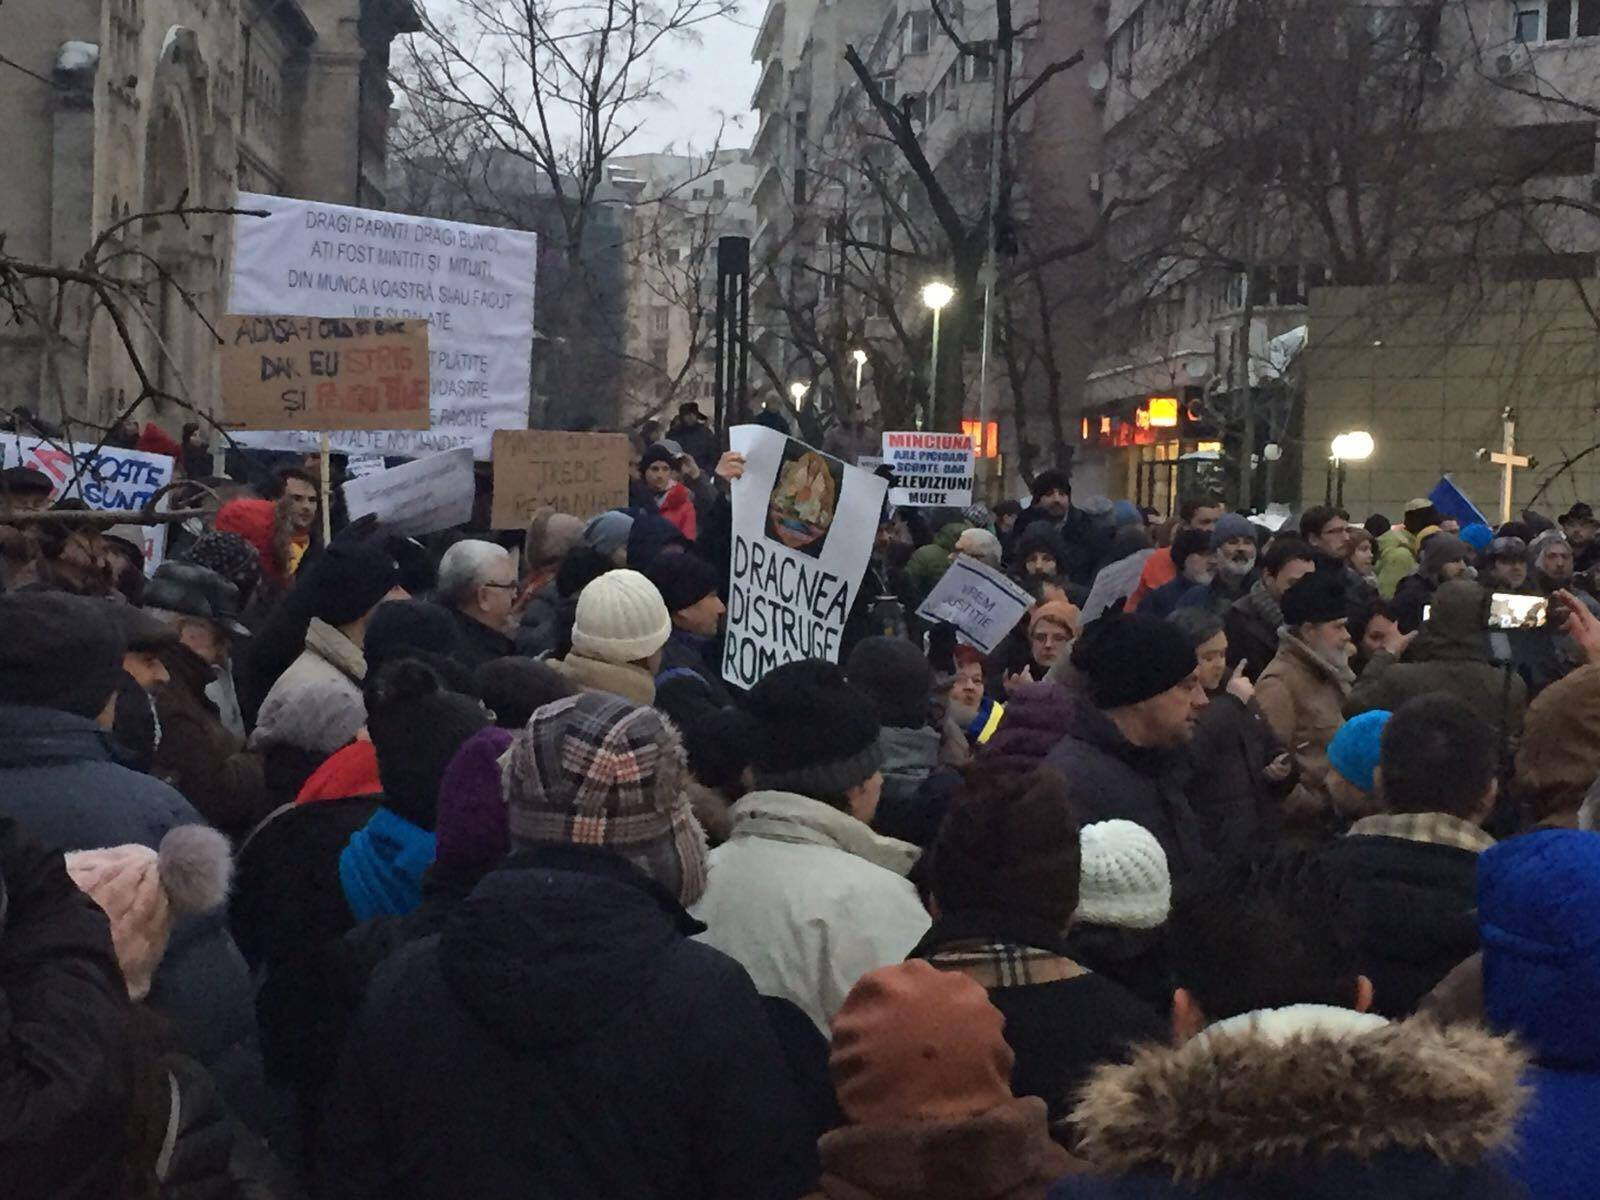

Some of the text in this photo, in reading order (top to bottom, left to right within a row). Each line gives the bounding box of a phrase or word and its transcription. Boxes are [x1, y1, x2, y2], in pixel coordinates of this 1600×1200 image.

[306, 211, 350, 234] DRAGI
[414, 225, 456, 247] DRAGI
[337, 244, 375, 264] FOST
[288, 269, 313, 289] DIN
[317, 273, 368, 295] MUNCA
[309, 350, 339, 378] EU
[889, 434, 972, 450] MINCIUNA
[895, 475, 972, 490] ELEVIZIUNI
[908, 492, 947, 504] MULTE
[734, 535, 848, 625] DRACNEA
